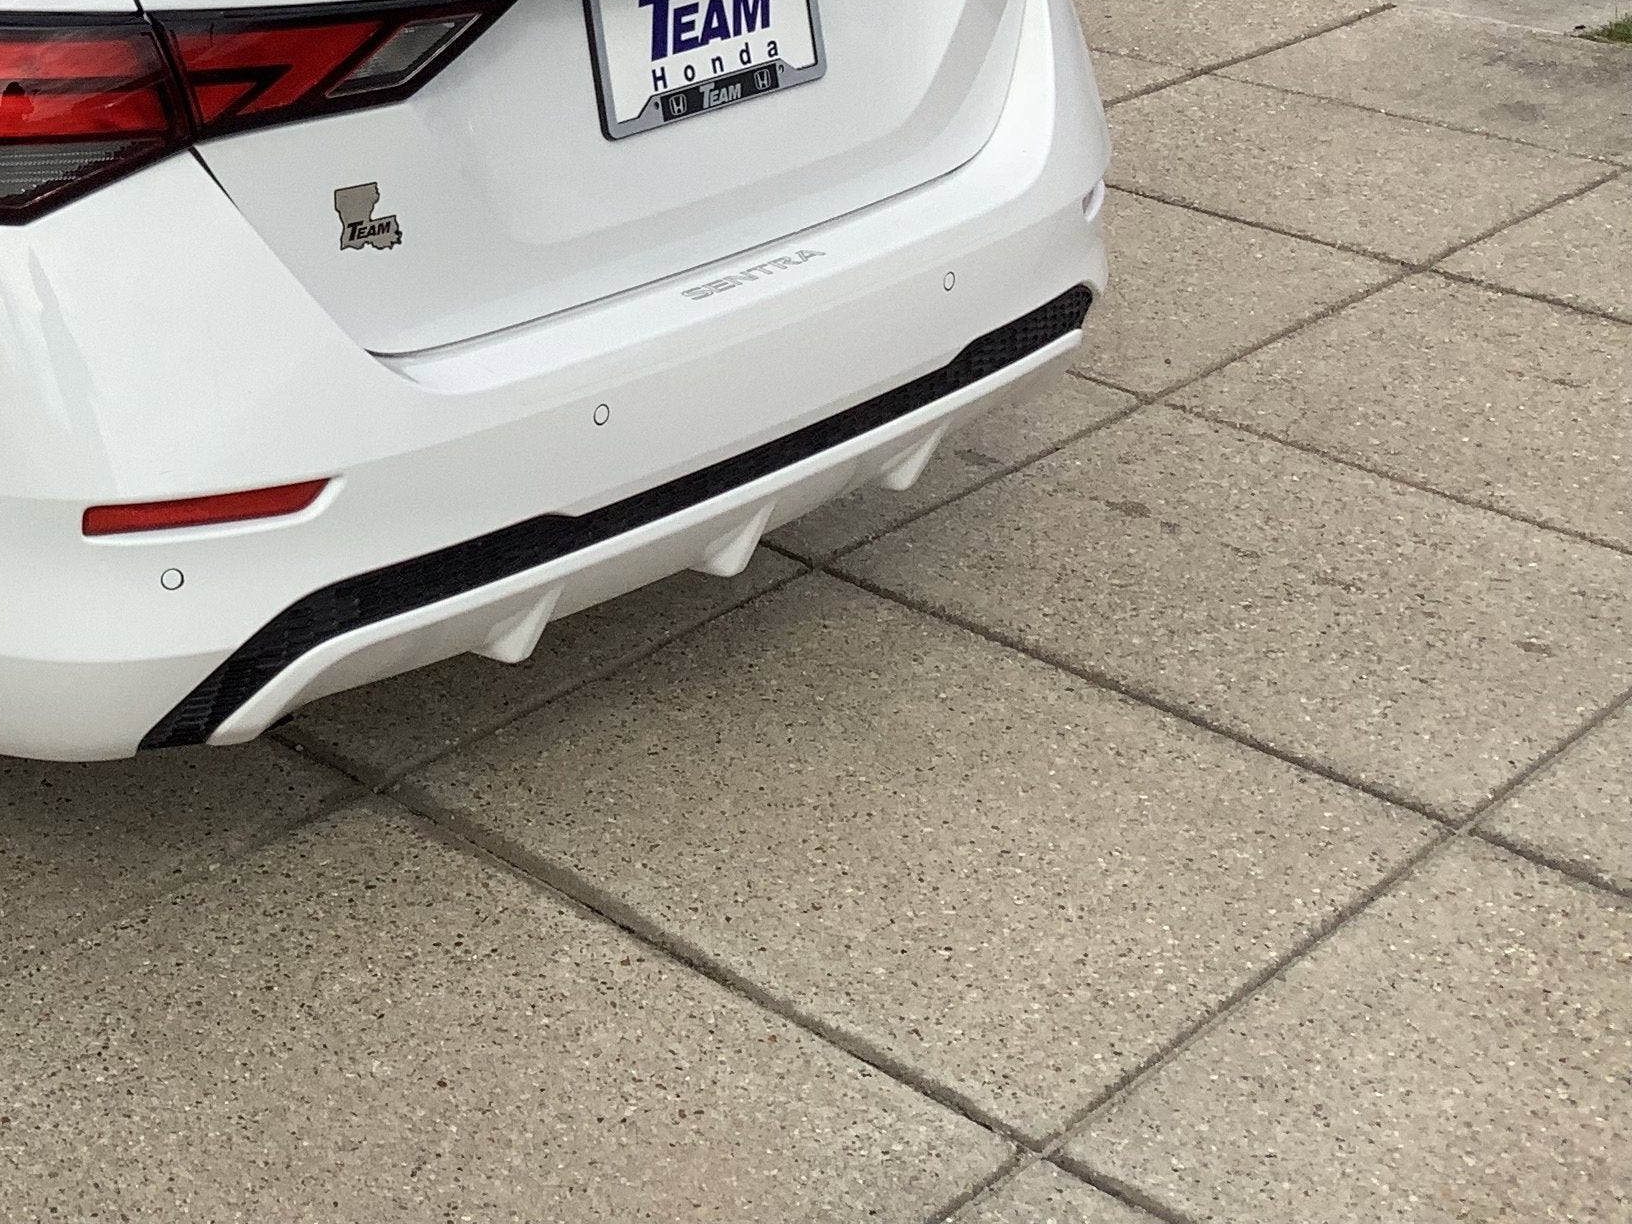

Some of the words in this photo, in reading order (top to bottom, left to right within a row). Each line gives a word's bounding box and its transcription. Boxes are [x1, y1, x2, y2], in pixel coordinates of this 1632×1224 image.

[699, 82, 742, 109] TEAM
[347, 220, 391, 242] TEAM
[681, 249, 826, 301] SENTRA
